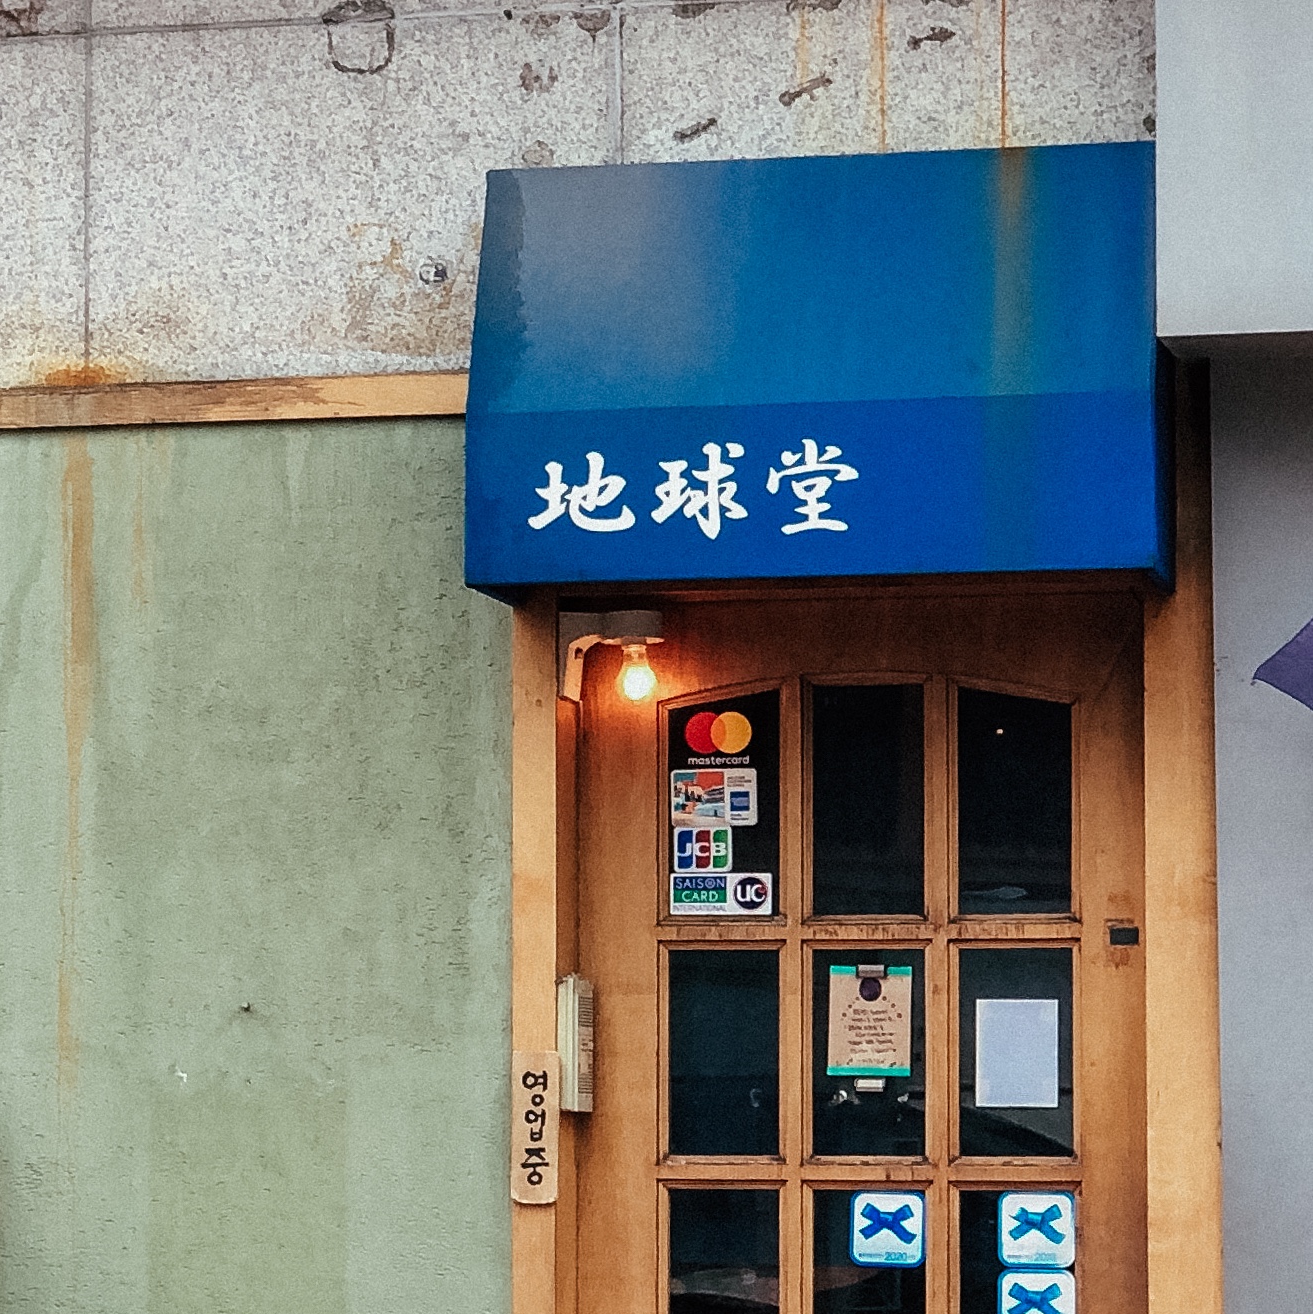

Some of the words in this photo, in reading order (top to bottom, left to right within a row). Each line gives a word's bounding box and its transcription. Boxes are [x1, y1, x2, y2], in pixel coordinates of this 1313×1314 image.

[527, 438, 860, 540] 地球堂
[687, 755, 750, 765] mastercard
[677, 842, 727, 857] JCB
[675, 878, 725, 889] SAISON
[681, 890, 718, 902] CARD
[736, 884, 766, 902] UC
[520, 1070, 550, 1186] 영업중
